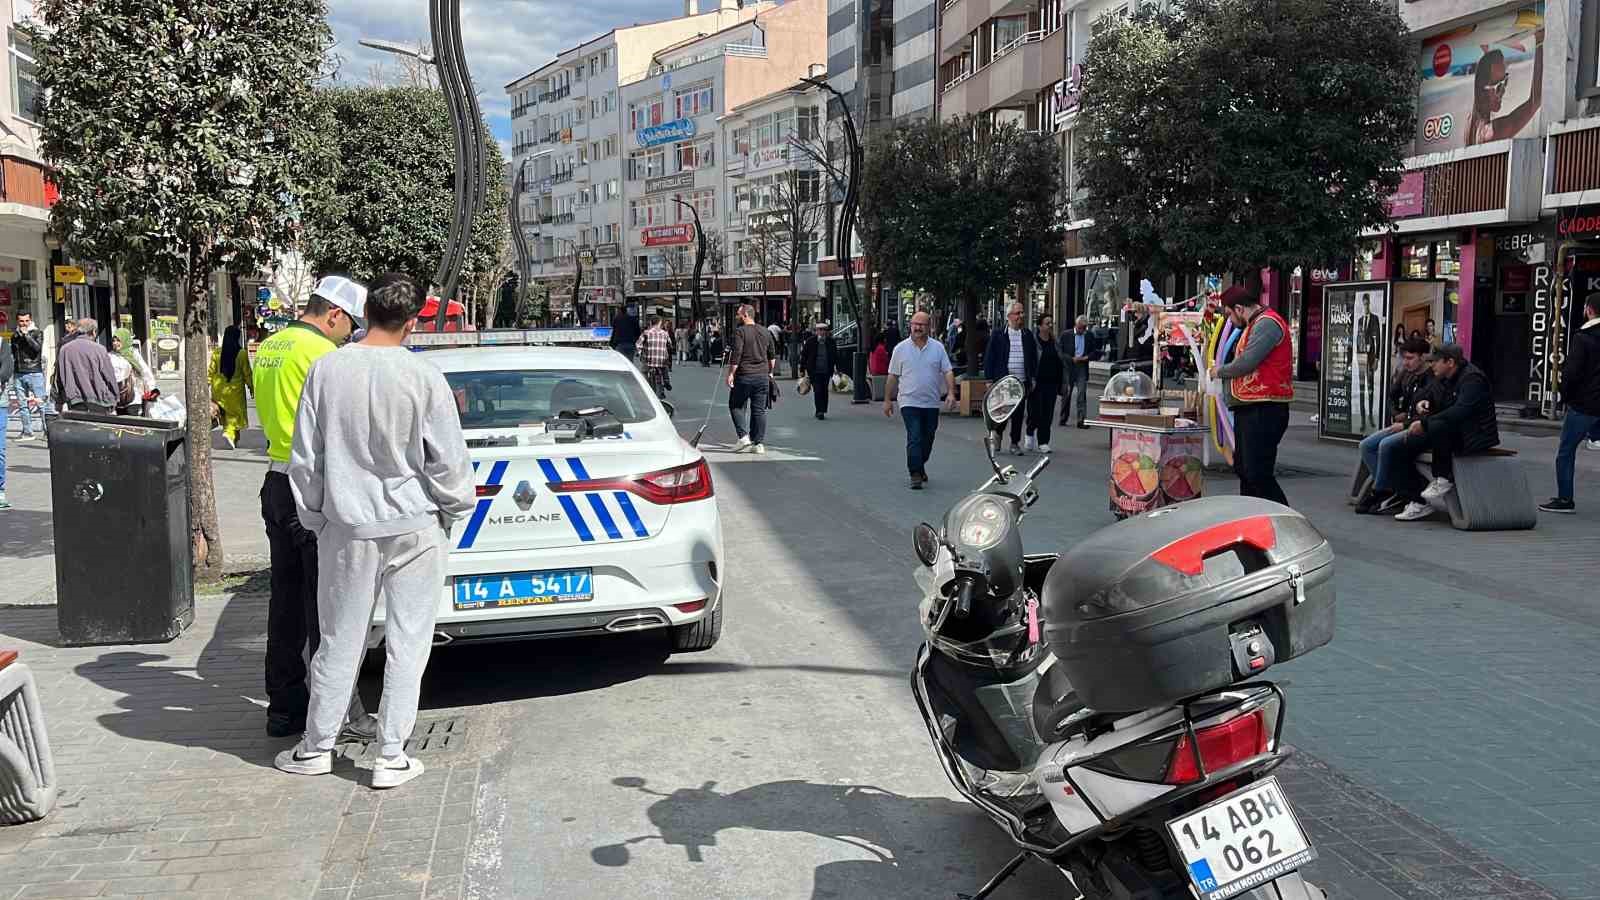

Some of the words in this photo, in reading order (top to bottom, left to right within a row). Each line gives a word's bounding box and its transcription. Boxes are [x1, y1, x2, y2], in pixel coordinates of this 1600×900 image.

[1424, 115, 1452, 138] eve
[1331, 312, 1352, 324] MARK
[1528, 266, 1549, 401] REBEKA
[488, 513, 561, 525] MEGANE
[462, 578, 488, 600] 14
[500, 576, 515, 598] A
[531, 571, 588, 595] 5417
[1182, 816, 1220, 849] 14
[1227, 789, 1282, 833] ABH
[1222, 829, 1283, 872] 062
[1200, 878, 1217, 890] TR
[1240, 872, 1264, 890] MOTO
[1262, 862, 1285, 880] BOLU
